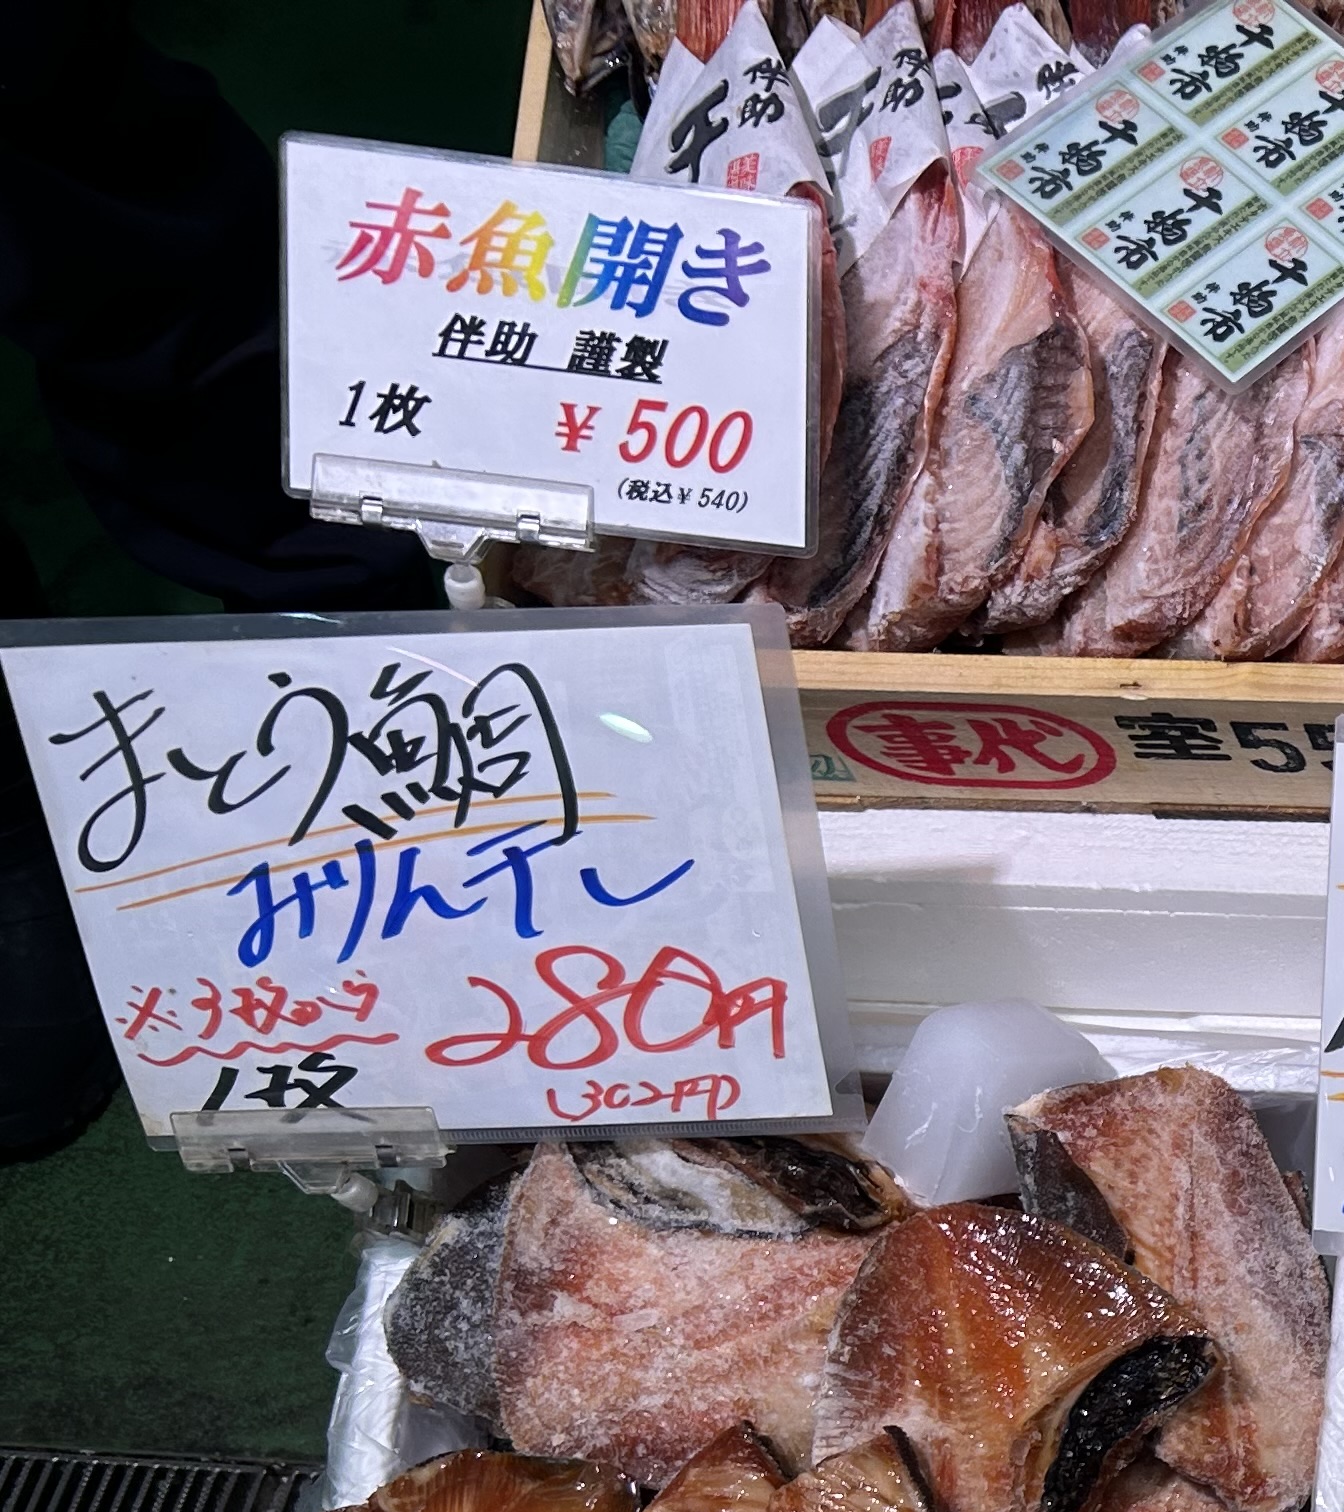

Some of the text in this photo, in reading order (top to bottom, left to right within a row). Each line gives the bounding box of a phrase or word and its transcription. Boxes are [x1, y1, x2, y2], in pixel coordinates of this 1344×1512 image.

[337, 188, 771, 327] 赤魚開き
[339, 381, 432, 437] 1枚
[433, 313, 667, 382] 伴助 謹製
[50, 662, 580, 873] まとう鯛
[228, 821, 694, 968] みりん干し
[425, 946, 788, 1069] 280円
